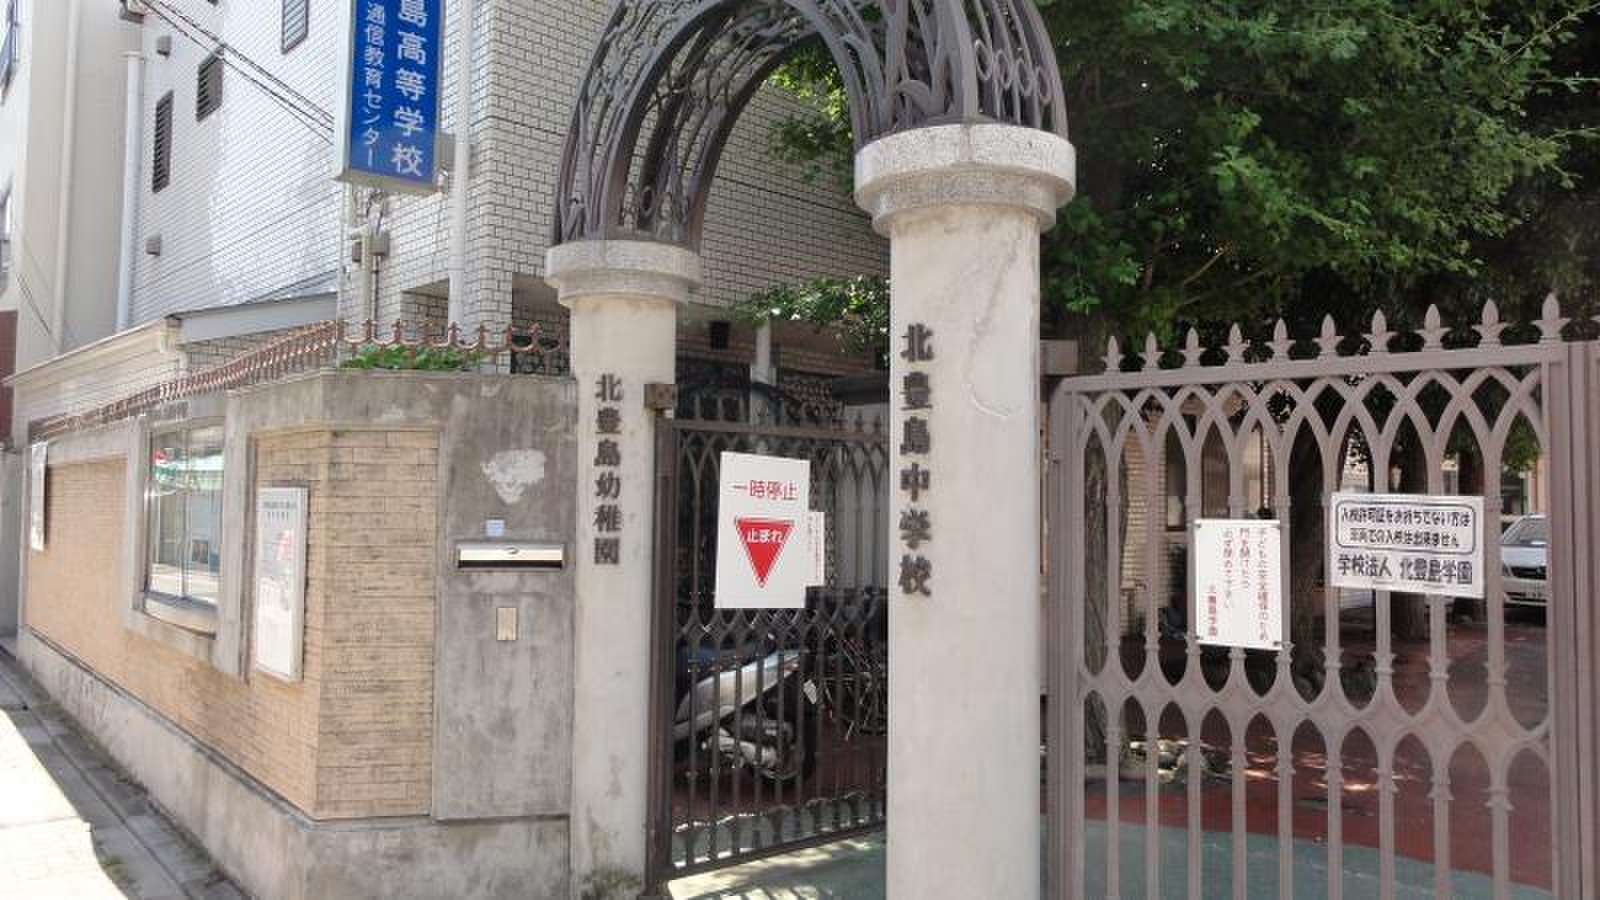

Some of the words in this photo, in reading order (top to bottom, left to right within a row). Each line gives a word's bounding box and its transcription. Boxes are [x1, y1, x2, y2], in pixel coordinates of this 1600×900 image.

[362, 2, 385, 167] 通信教育センター
[592, 373, 622, 565] 北豊島幼稚園
[732, 479, 799, 501] 一時停止
[746, 528, 785, 543] 止まれ
[1338, 554, 1393, 577] 学校法人
[1400, 557, 1473, 585] 北豊島学園
